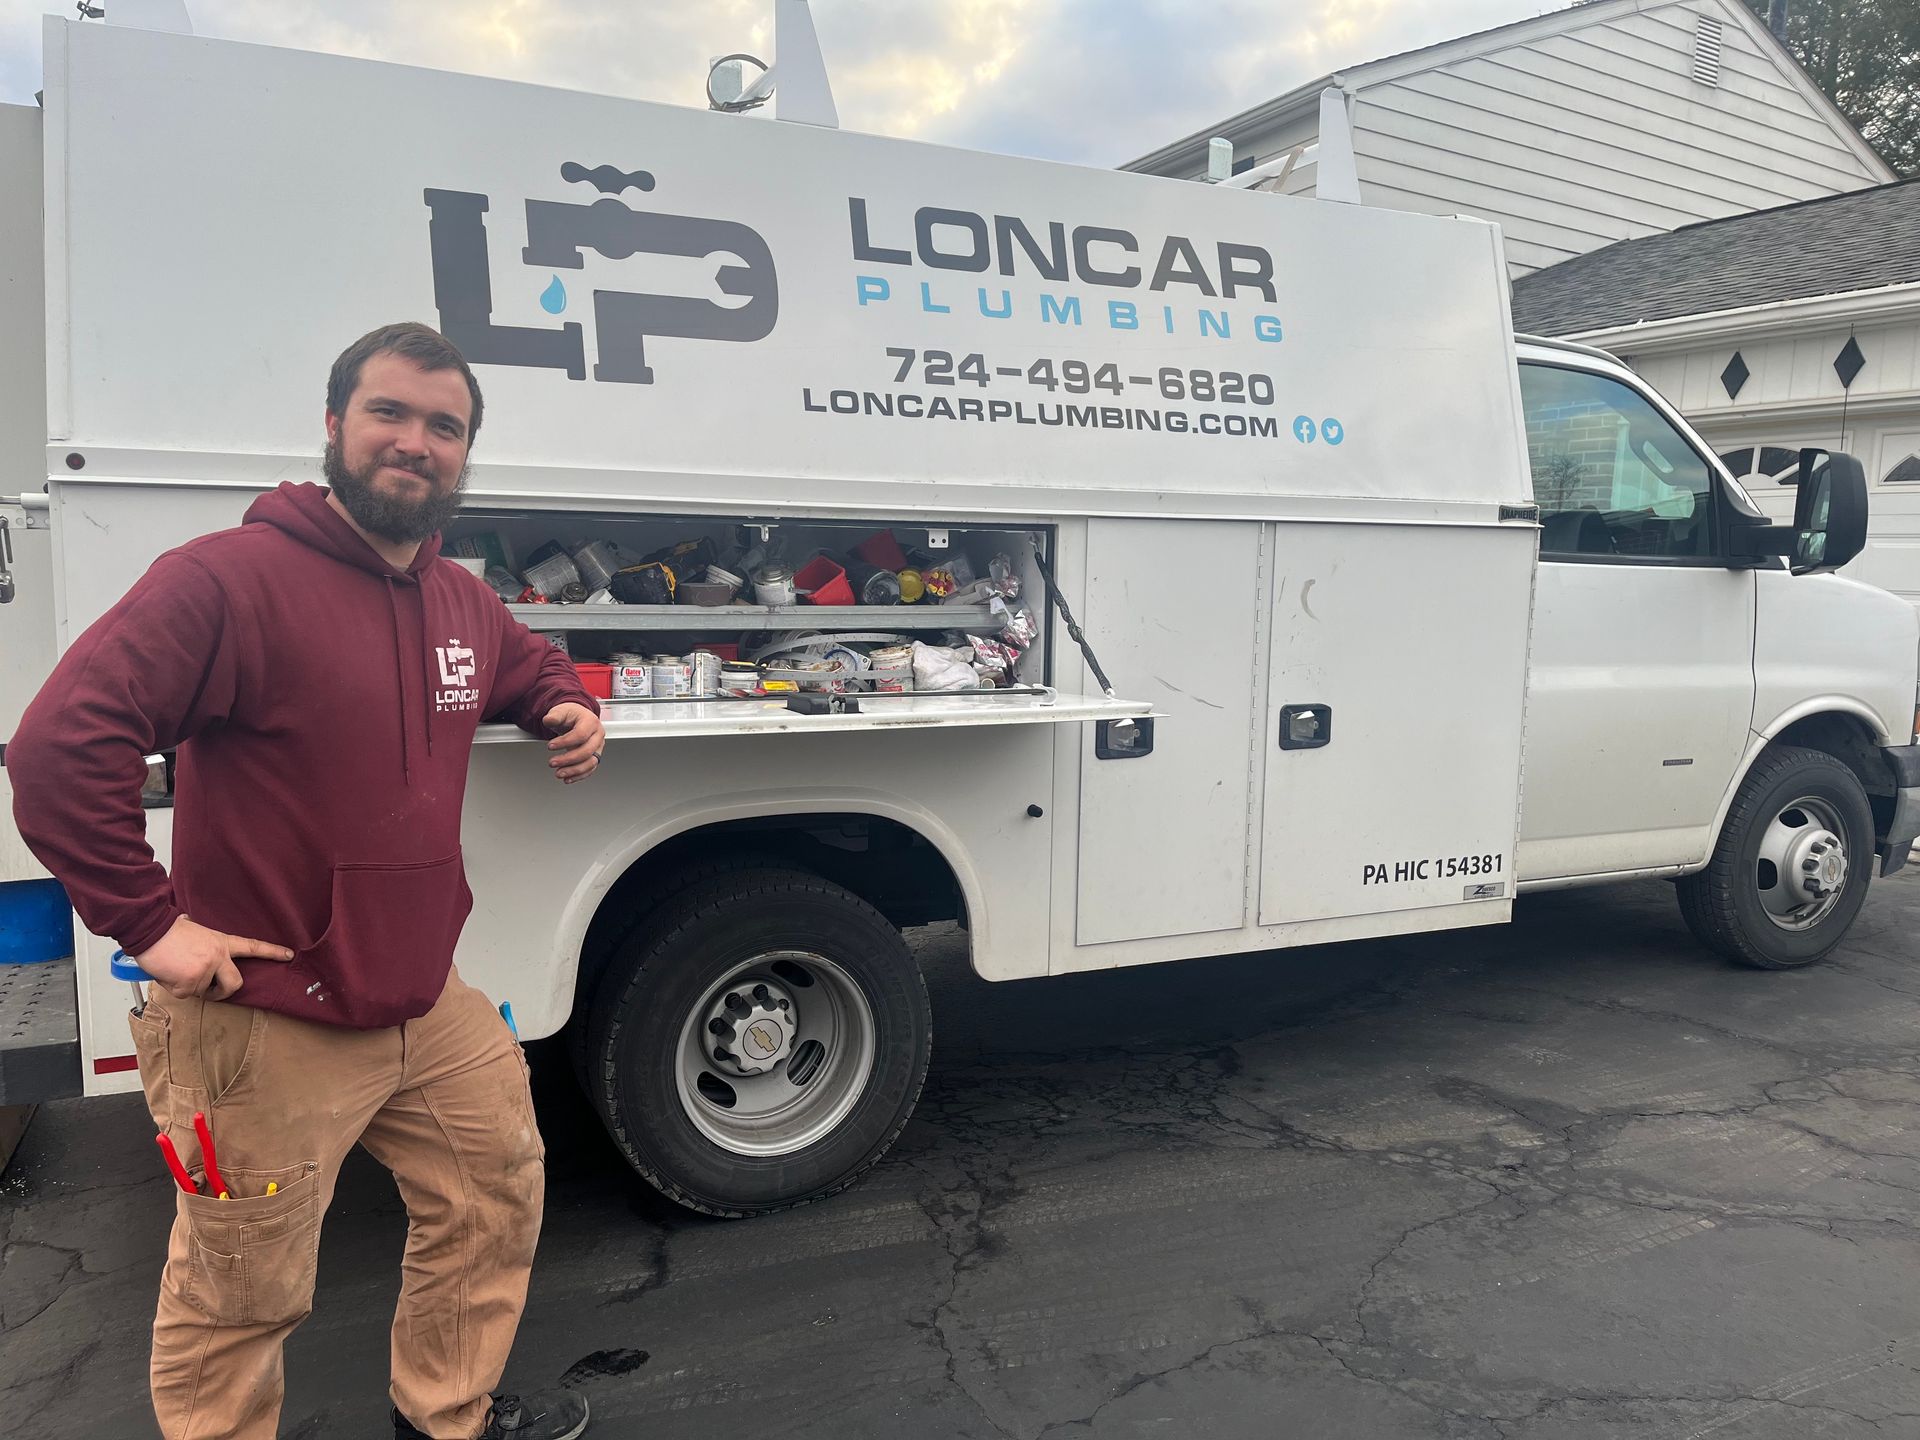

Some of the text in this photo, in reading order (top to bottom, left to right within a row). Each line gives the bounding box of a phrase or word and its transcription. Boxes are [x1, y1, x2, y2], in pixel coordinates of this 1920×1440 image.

[848, 196, 1278, 304] LONCAR
[856, 275, 1283, 343] PLUMBING
[885, 346, 1275, 406] 724-494-6820
[803, 387, 1278, 438] LONCARPLUMBING.COM
[1500, 507, 1538, 521] KNAPHEIDE
[1363, 853, 1502, 886] PA HIC 154381
